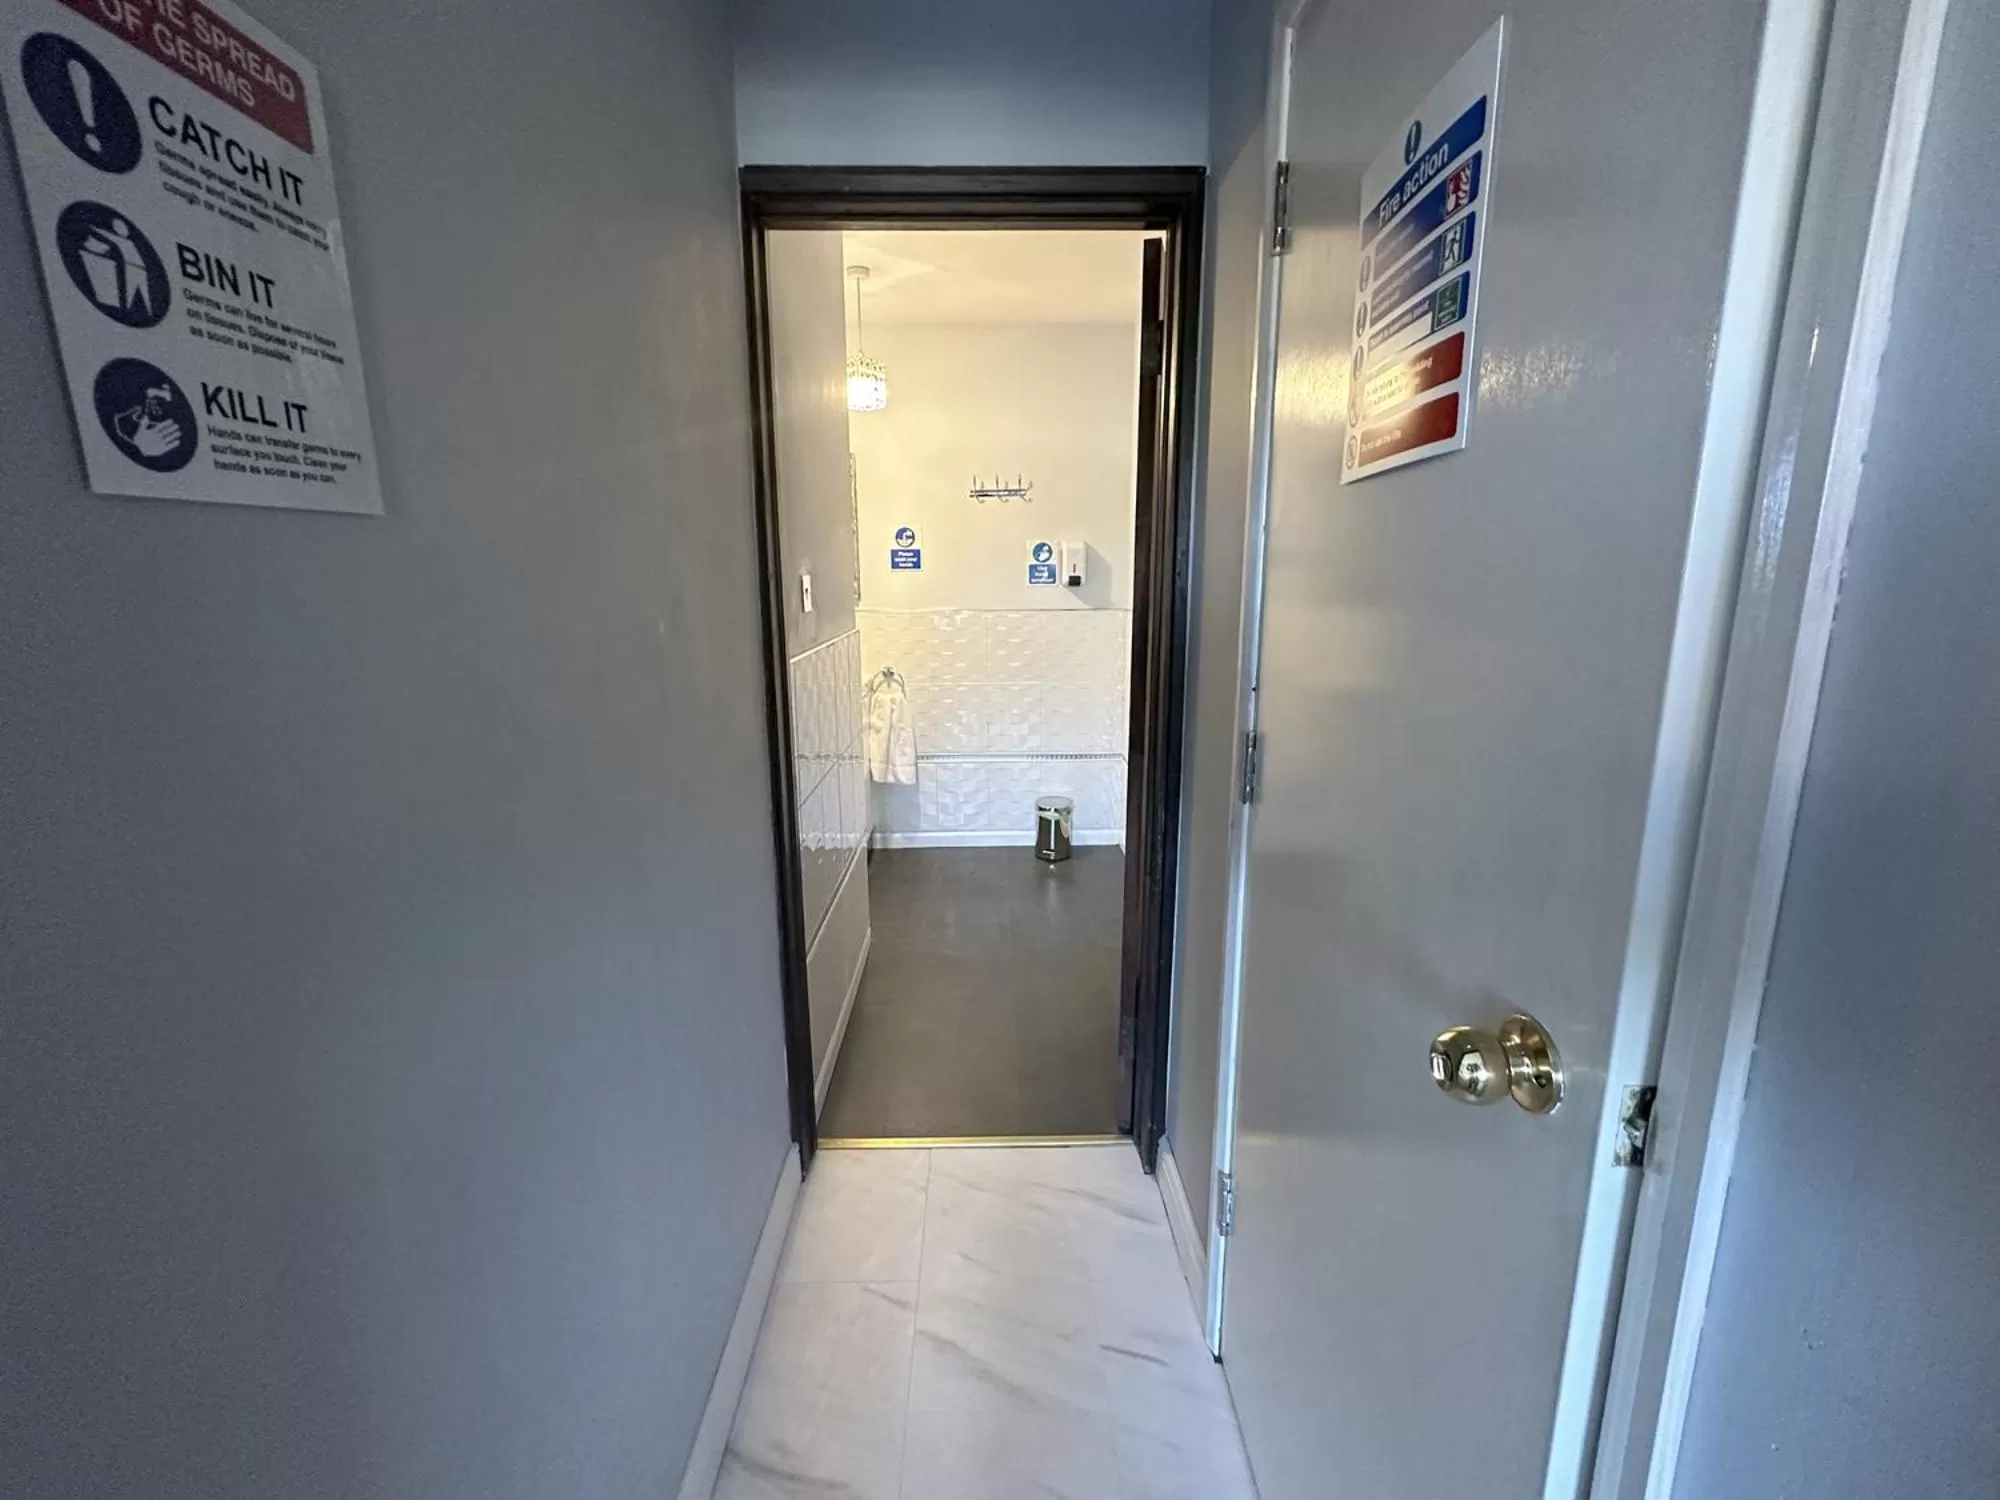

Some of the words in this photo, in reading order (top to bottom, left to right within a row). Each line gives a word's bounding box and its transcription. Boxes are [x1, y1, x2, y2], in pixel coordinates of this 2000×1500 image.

[98, 0, 142, 31] OF
[153, 23, 255, 107] GERMS
[193, 13, 296, 101] SPREAD
[149, 96, 272, 190] CATCH
[279, 168, 302, 205] IT
[1379, 193, 1400, 229] Fire
[1403, 144, 1448, 201] action
[177, 243, 240, 296] BIN
[249, 271, 275, 308] IT
[201, 382, 278, 427] KILL
[284, 401, 307, 433] IT
[206, 424, 244, 442] Hands
[210, 443, 252, 458] surface
[252, 450, 273, 462] you
[301, 472, 319, 482] you
